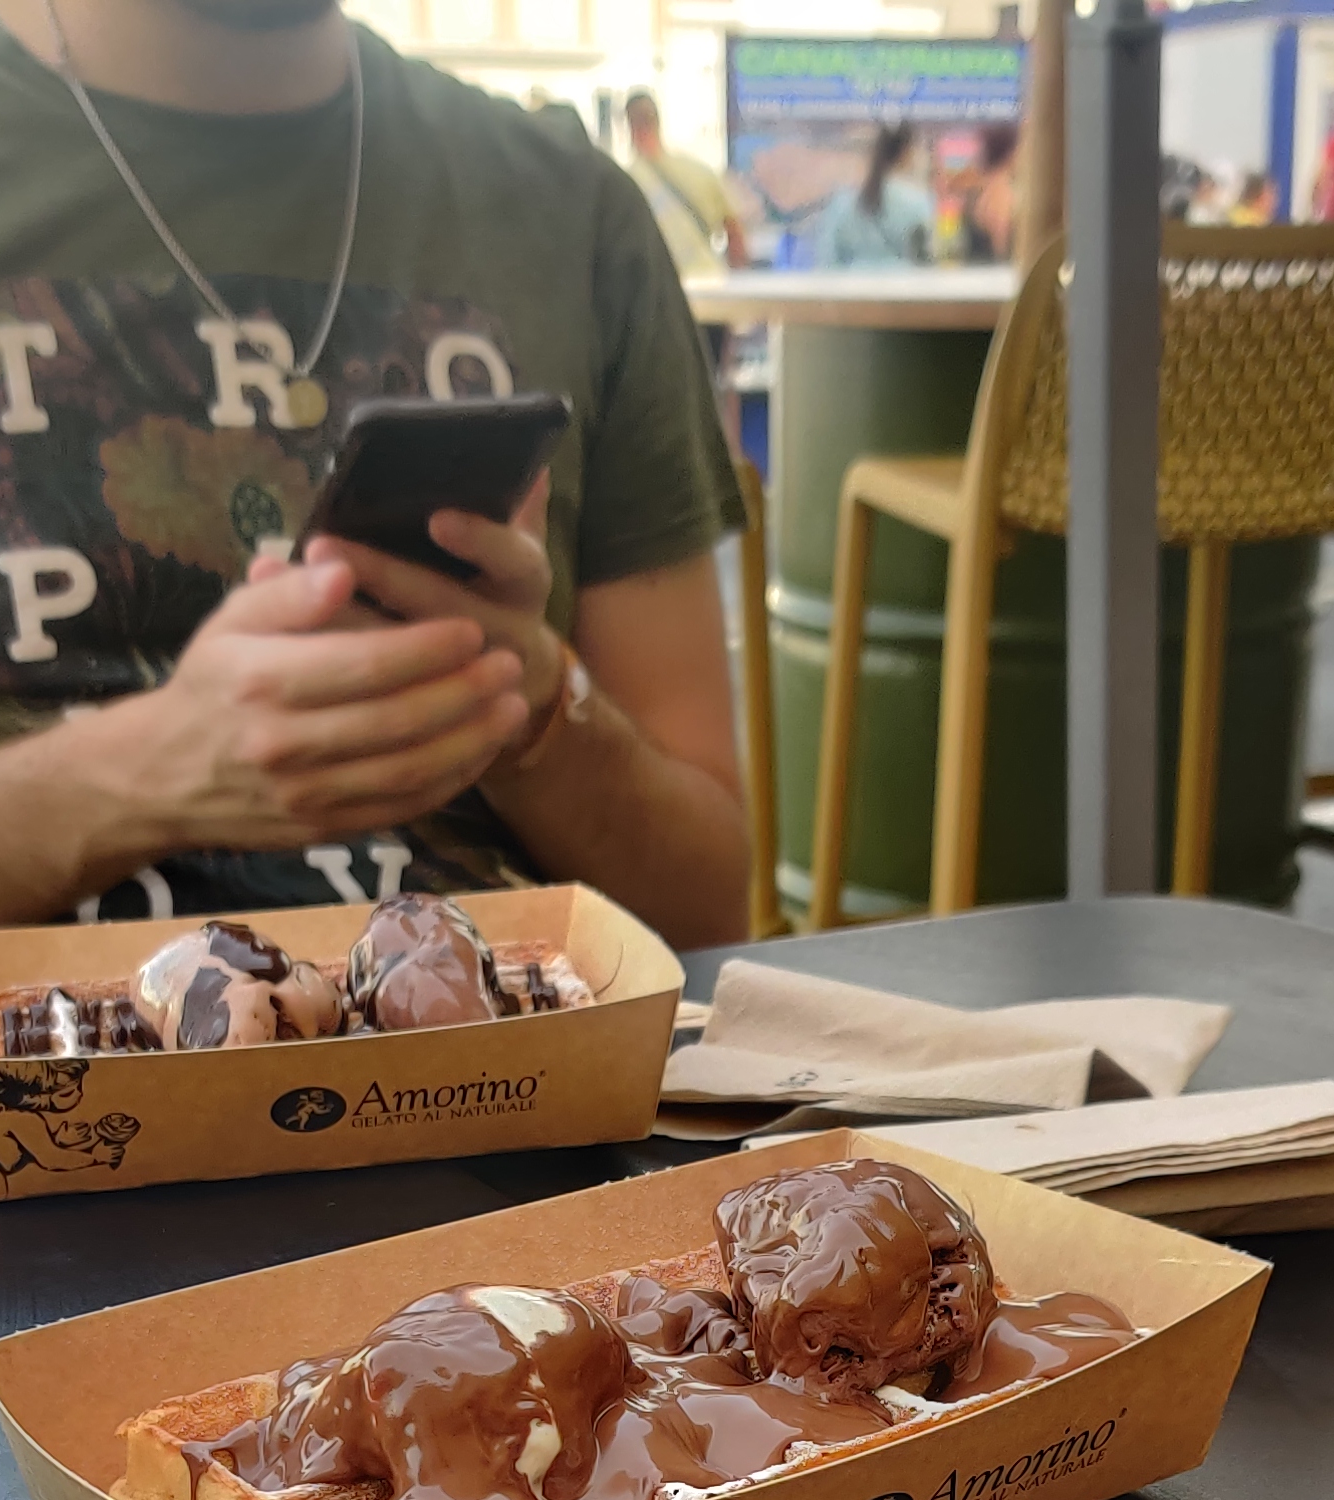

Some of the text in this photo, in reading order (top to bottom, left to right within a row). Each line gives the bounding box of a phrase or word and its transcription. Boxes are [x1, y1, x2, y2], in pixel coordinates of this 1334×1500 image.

[351, 1099, 537, 1130] GELATO AL NATURALE
[352, 1071, 538, 1117] Amorino
[1014, 1448, 1108, 1497] NATURALE
